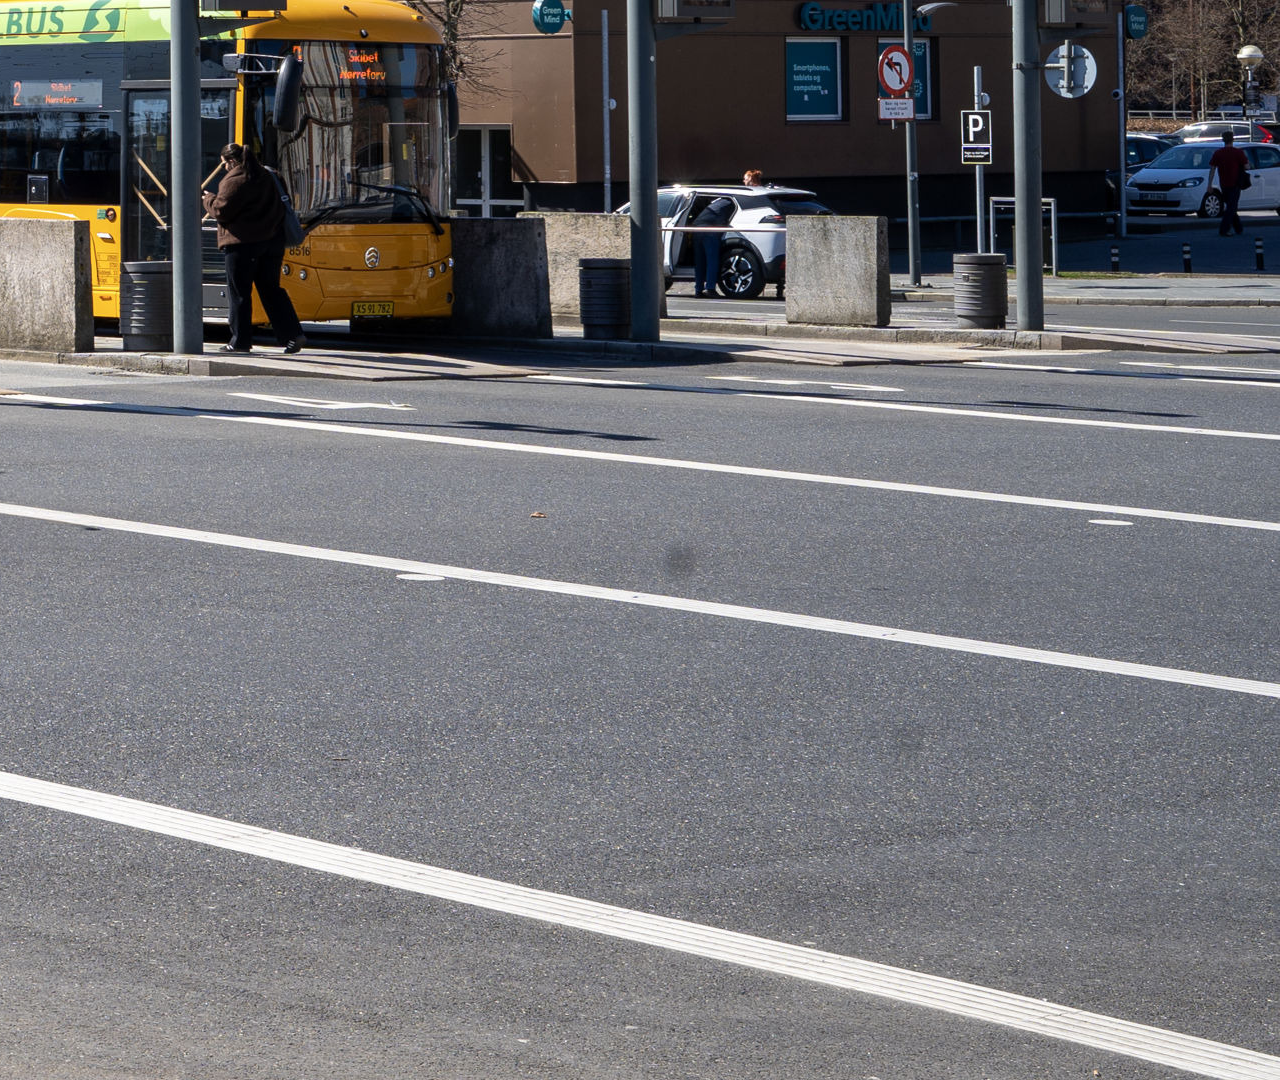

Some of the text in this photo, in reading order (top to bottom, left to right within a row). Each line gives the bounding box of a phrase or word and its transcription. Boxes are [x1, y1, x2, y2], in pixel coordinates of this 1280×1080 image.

[542, 6, 561, 14] Green
[544, 15, 560, 23] Mind
[1131, 14, 1146, 22] Green
[1131, 22, 1145, 30] Mind
[348, 49, 378, 63] Skibet
[13, 81, 22, 106] 2
[968, 114, 983, 142] P
[289, 246, 311, 256] 8516
[356, 303, 391, 313] XS 91 782
